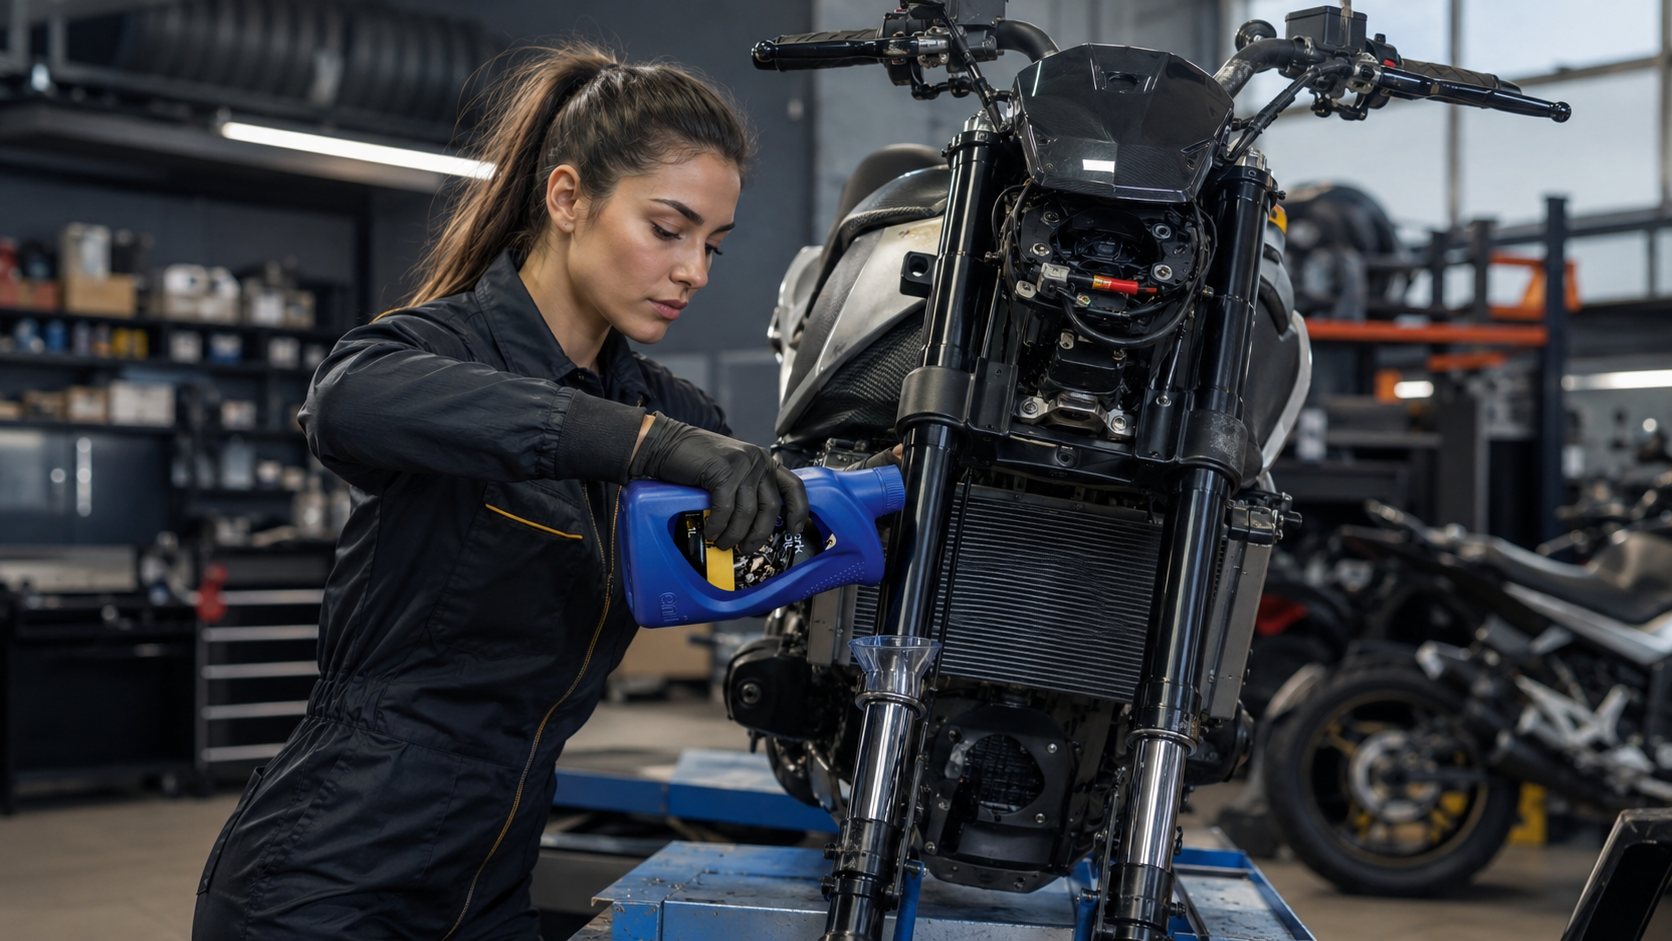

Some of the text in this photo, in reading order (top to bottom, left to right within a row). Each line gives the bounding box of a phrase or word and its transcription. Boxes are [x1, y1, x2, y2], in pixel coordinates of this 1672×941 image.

[688, 527, 697, 538] 1L
[794, 533, 805, 554] ork
[660, 591, 688, 622] eni
